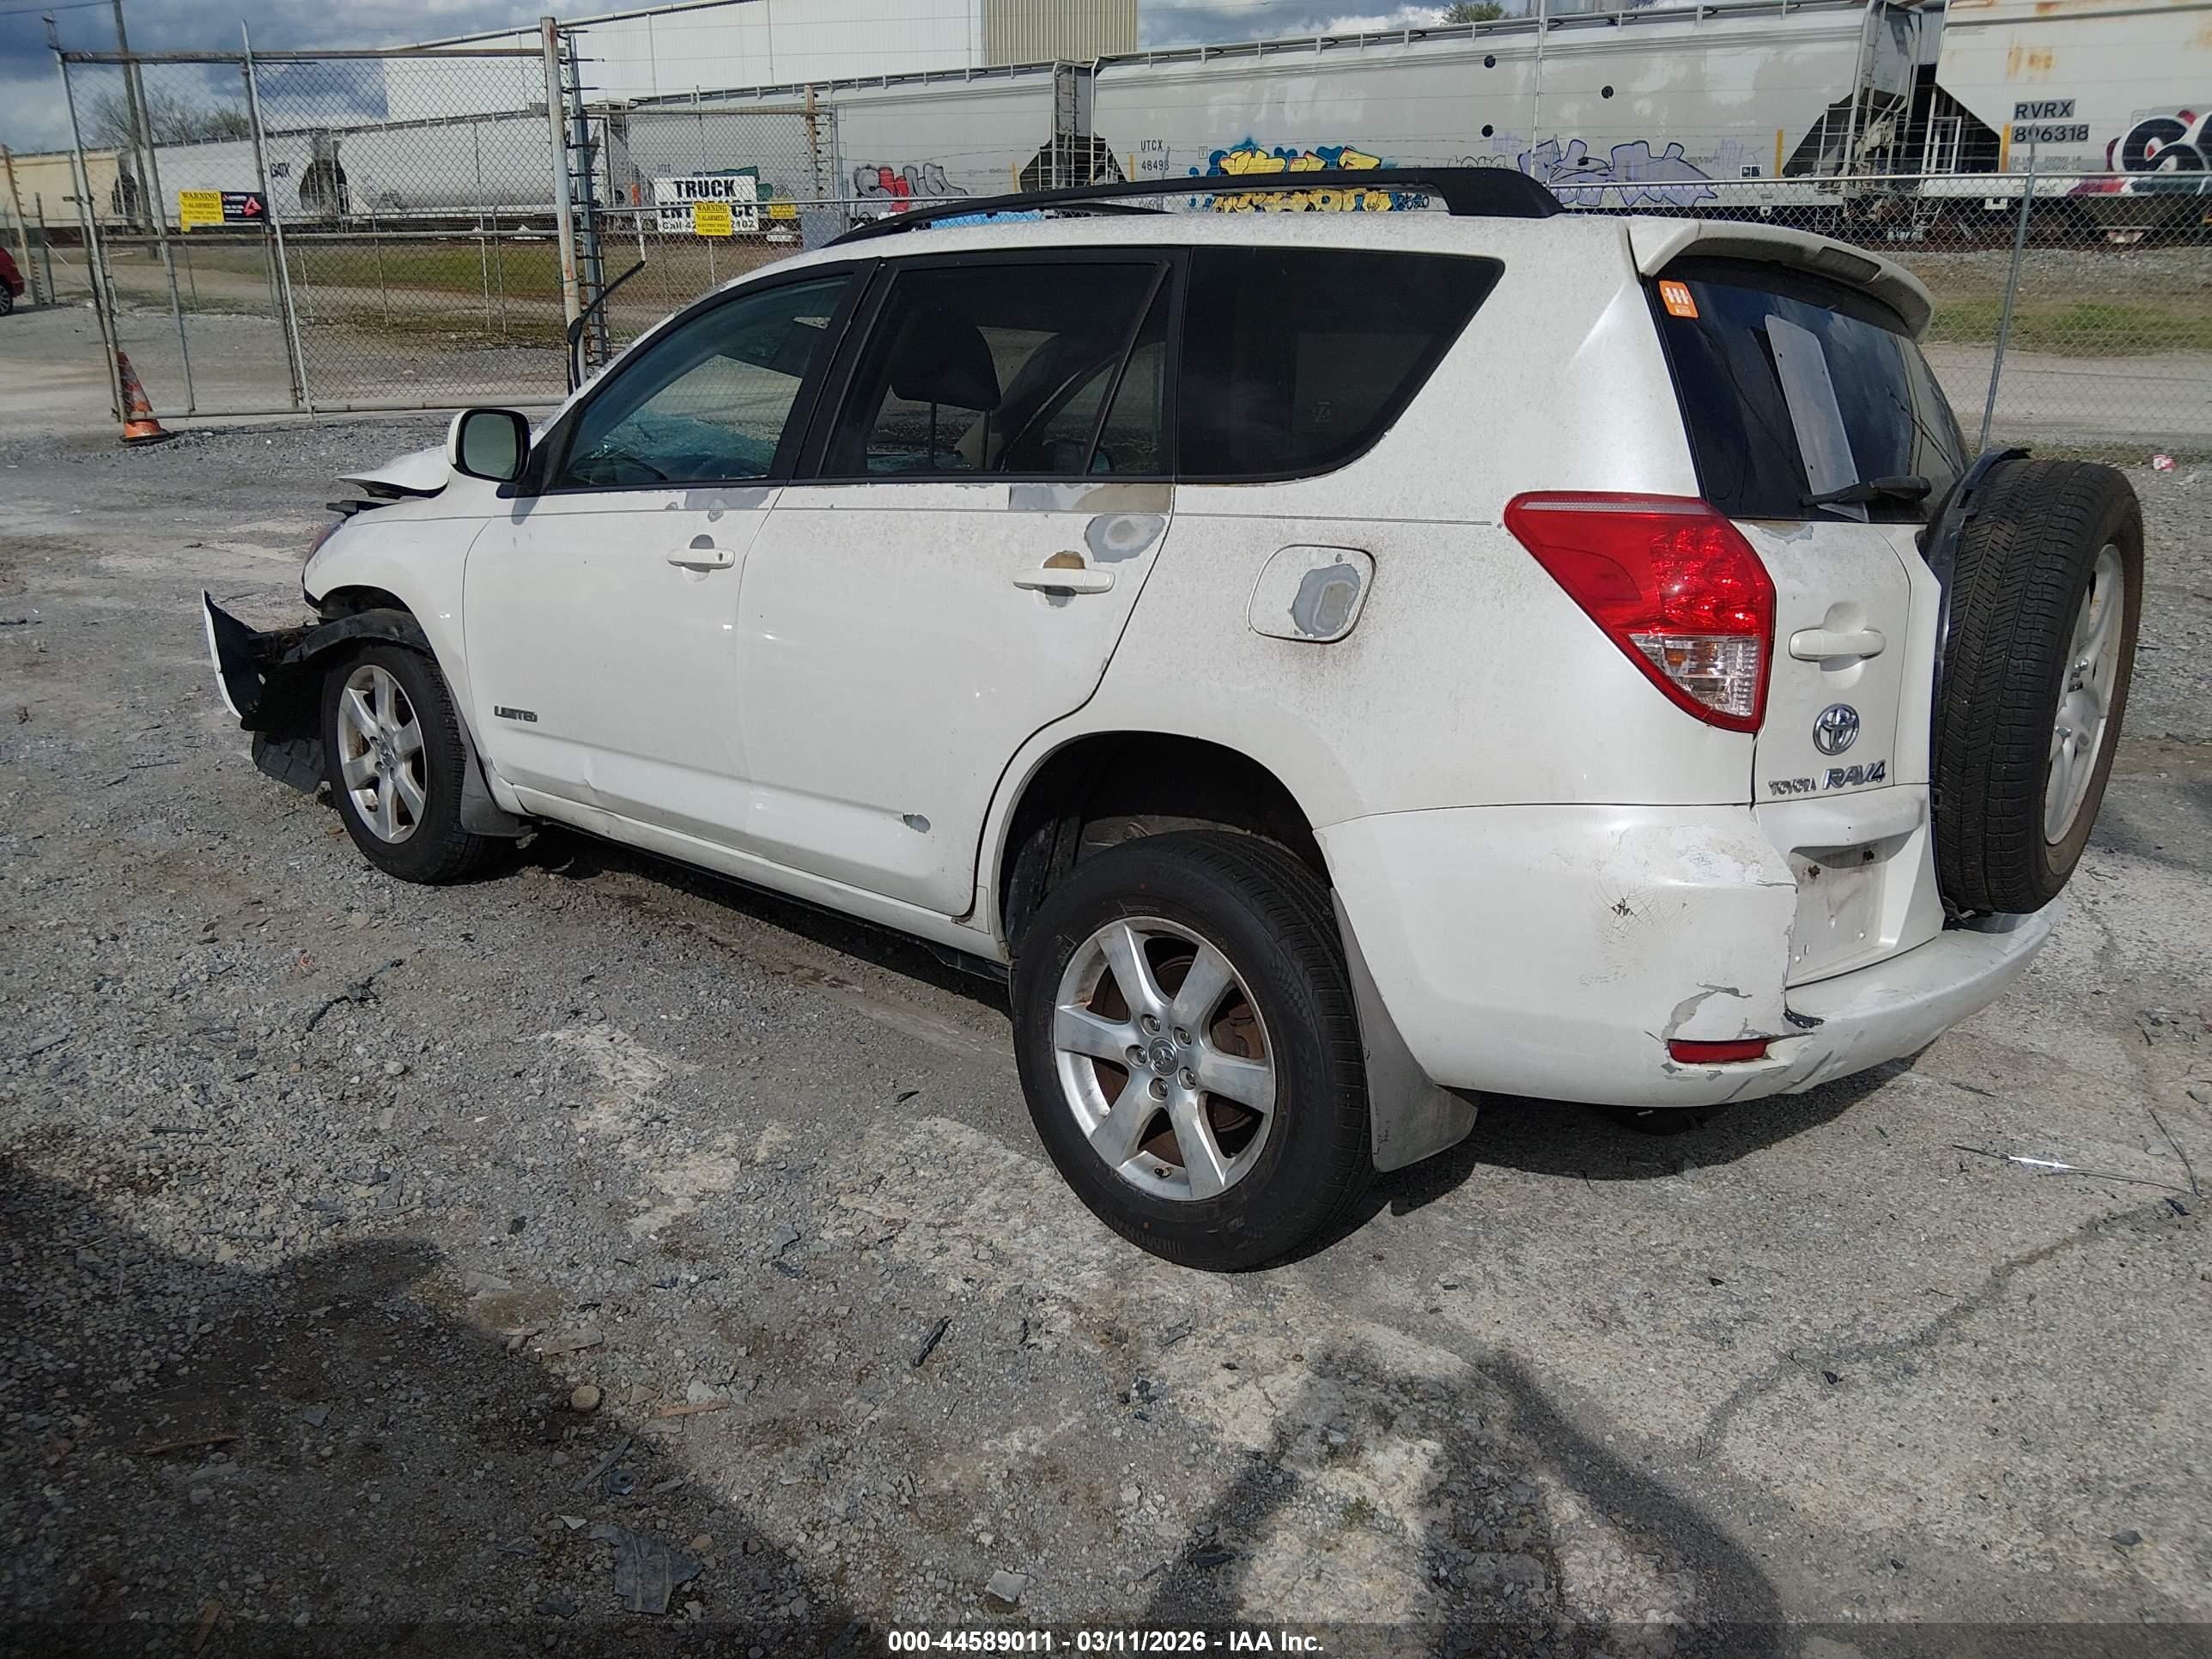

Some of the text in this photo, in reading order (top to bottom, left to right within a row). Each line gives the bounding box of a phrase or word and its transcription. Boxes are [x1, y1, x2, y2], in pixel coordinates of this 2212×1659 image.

[2014, 102, 2073, 119] RVRX
[1140, 139, 1164, 152] UTCX
[180, 191, 219, 201] WARNING
[674, 179, 738, 198] TRUCK
[696, 204, 728, 213] WARNING
[663, 221, 682, 230] Call
[494, 705, 538, 723] LIMITED
[1768, 758, 1887, 796] TOYOTA RAV4
